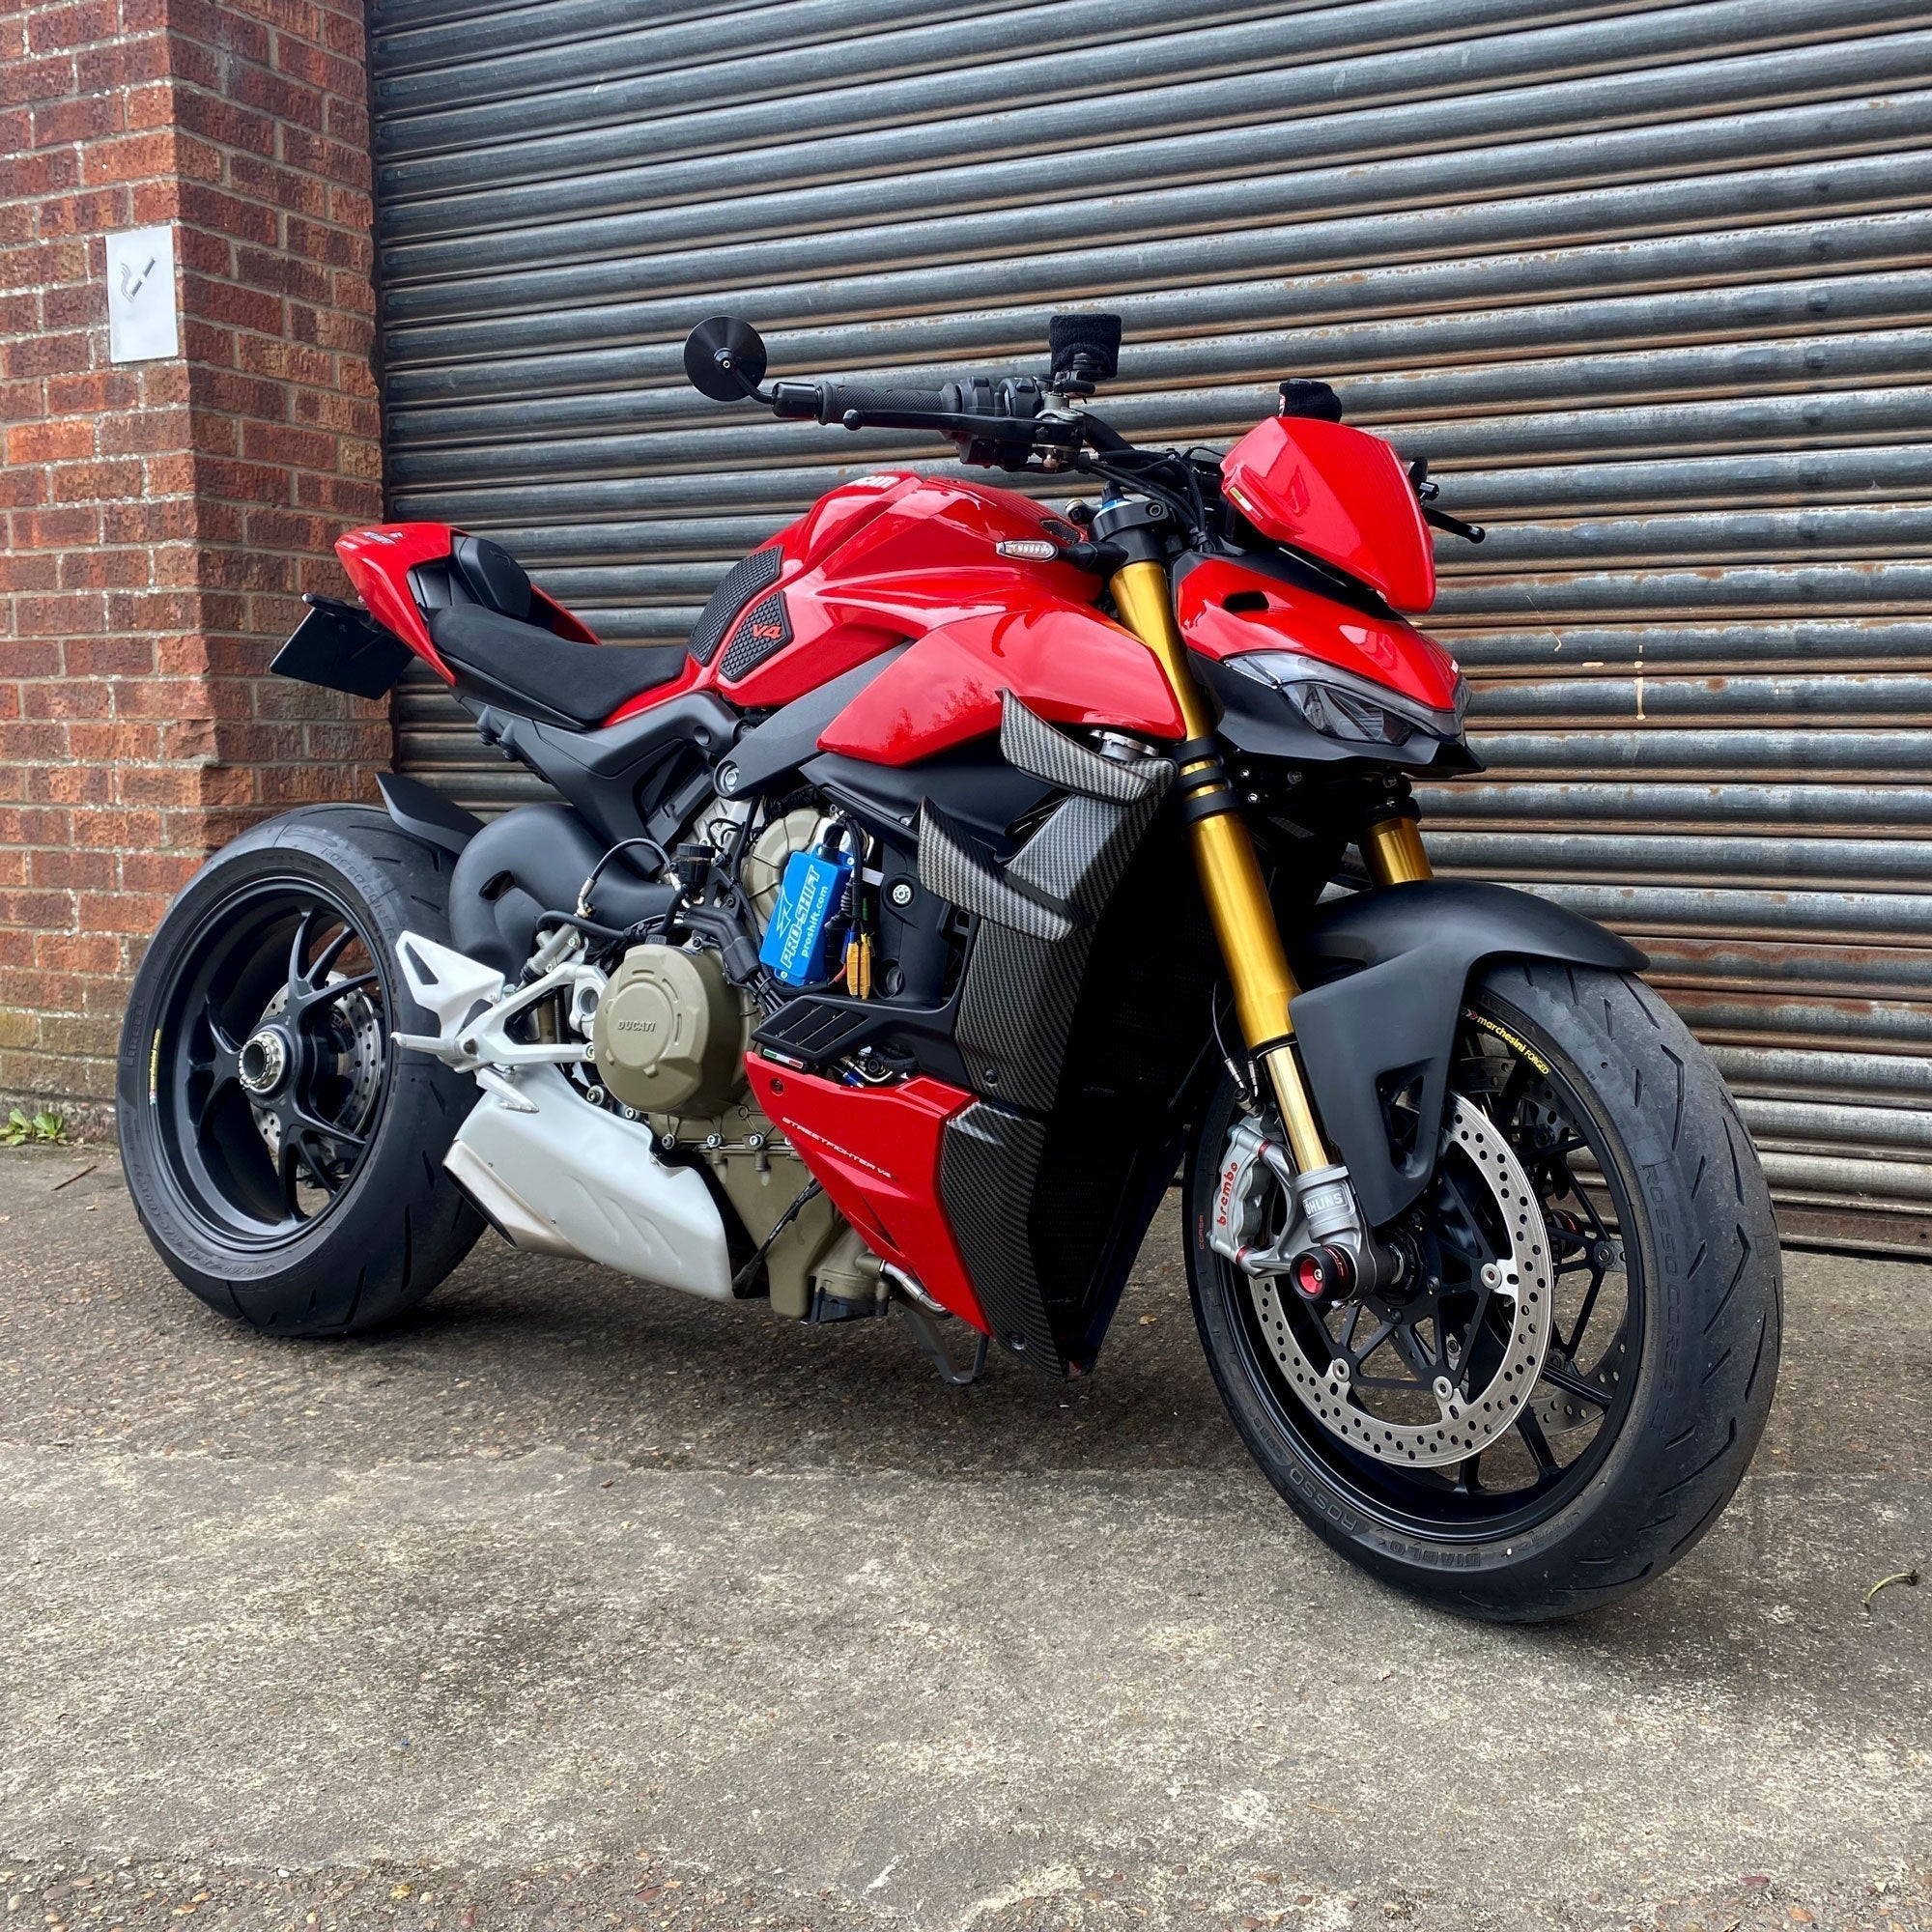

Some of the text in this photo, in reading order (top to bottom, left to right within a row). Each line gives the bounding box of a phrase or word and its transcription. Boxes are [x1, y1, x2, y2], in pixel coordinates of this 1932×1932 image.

[753, 624, 781, 639] V4
[781, 864, 820, 969] PRO-SHIFT
[801, 886, 829, 957] proshift.com
[618, 1020, 656, 1032] DUCATI
[1477, 1016, 1526, 1053] marchesini
[1523, 1049, 1549, 1074] FORGED
[781, 1117, 893, 1179] STREETFIGHTER V4
[1216, 1162, 1238, 1227] brembo
[1304, 1192, 1344, 1215] ÖHLINS
[1643, 1163, 1679, 1276] ROSSO
[1660, 1284, 1683, 1398] CORSA
[1289, 1467, 1358, 1532] ROSSO
[1388, 1540, 1481, 1567] DIABLO
